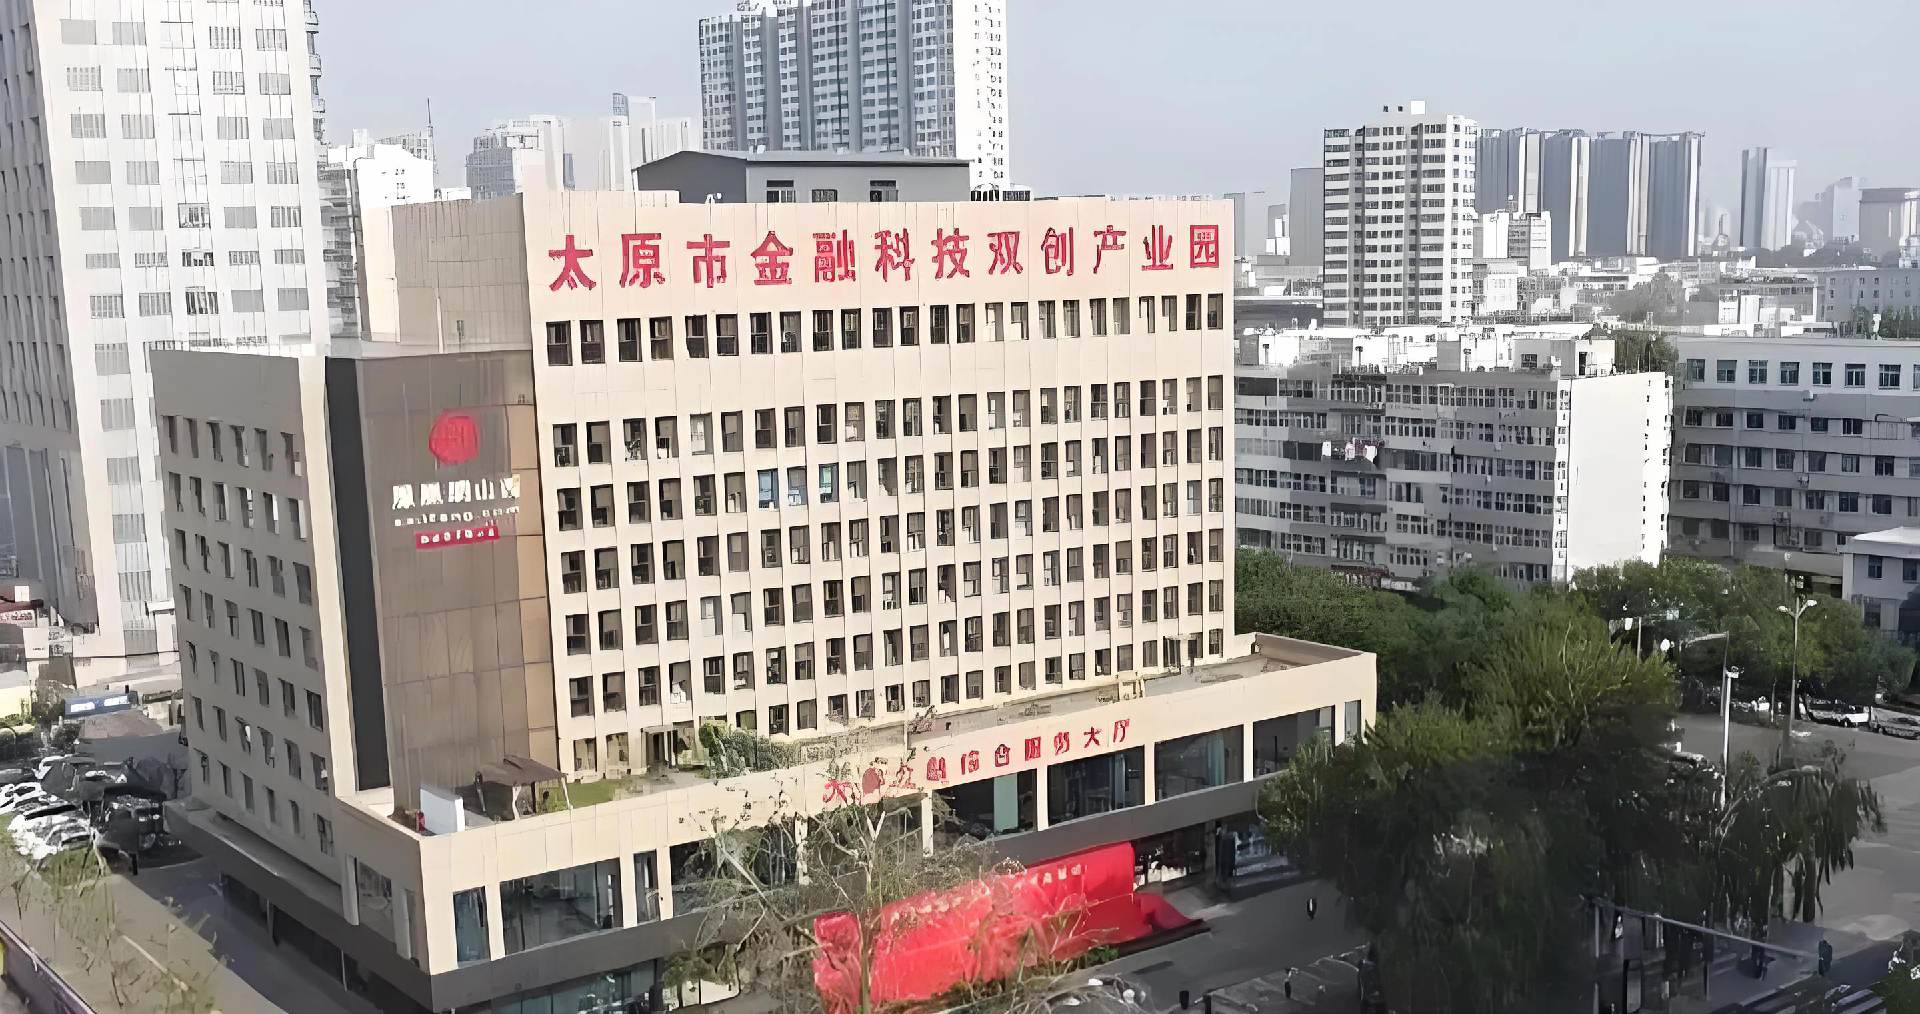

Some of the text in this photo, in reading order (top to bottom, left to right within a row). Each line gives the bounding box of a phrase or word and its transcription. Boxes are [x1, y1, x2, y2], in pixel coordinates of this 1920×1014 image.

[548, 224, 1219, 291] 太原市金融科技双创产业园
